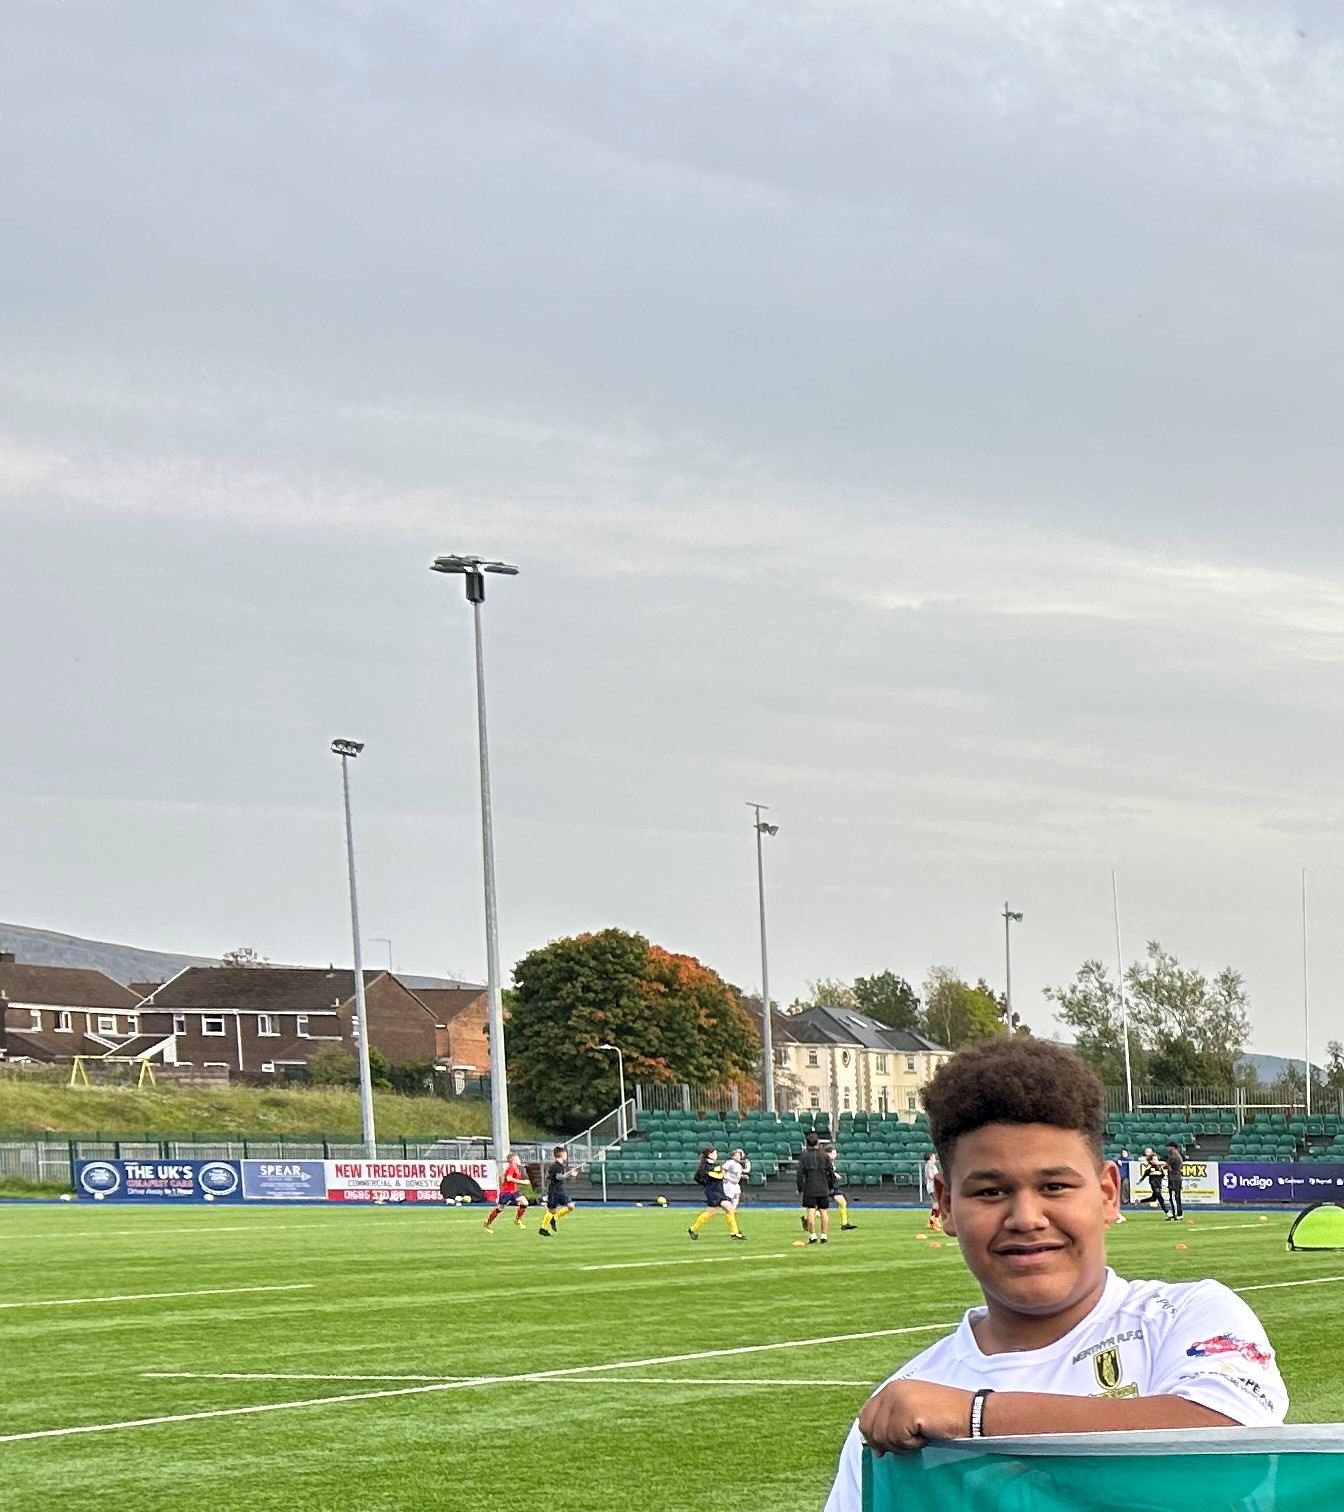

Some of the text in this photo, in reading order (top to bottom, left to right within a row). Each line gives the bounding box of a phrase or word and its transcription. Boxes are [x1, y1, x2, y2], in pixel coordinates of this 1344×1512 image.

[125, 1165, 155, 1179] THE
[157, 1165, 193, 1179] UK'S
[259, 1164, 301, 1176] SPEAR
[335, 1163, 362, 1178] NEW
[460, 1163, 488, 1178] HIRE
[1240, 1175, 1273, 1190] Indigo
[1072, 1336, 1116, 1366] MERTHYR
